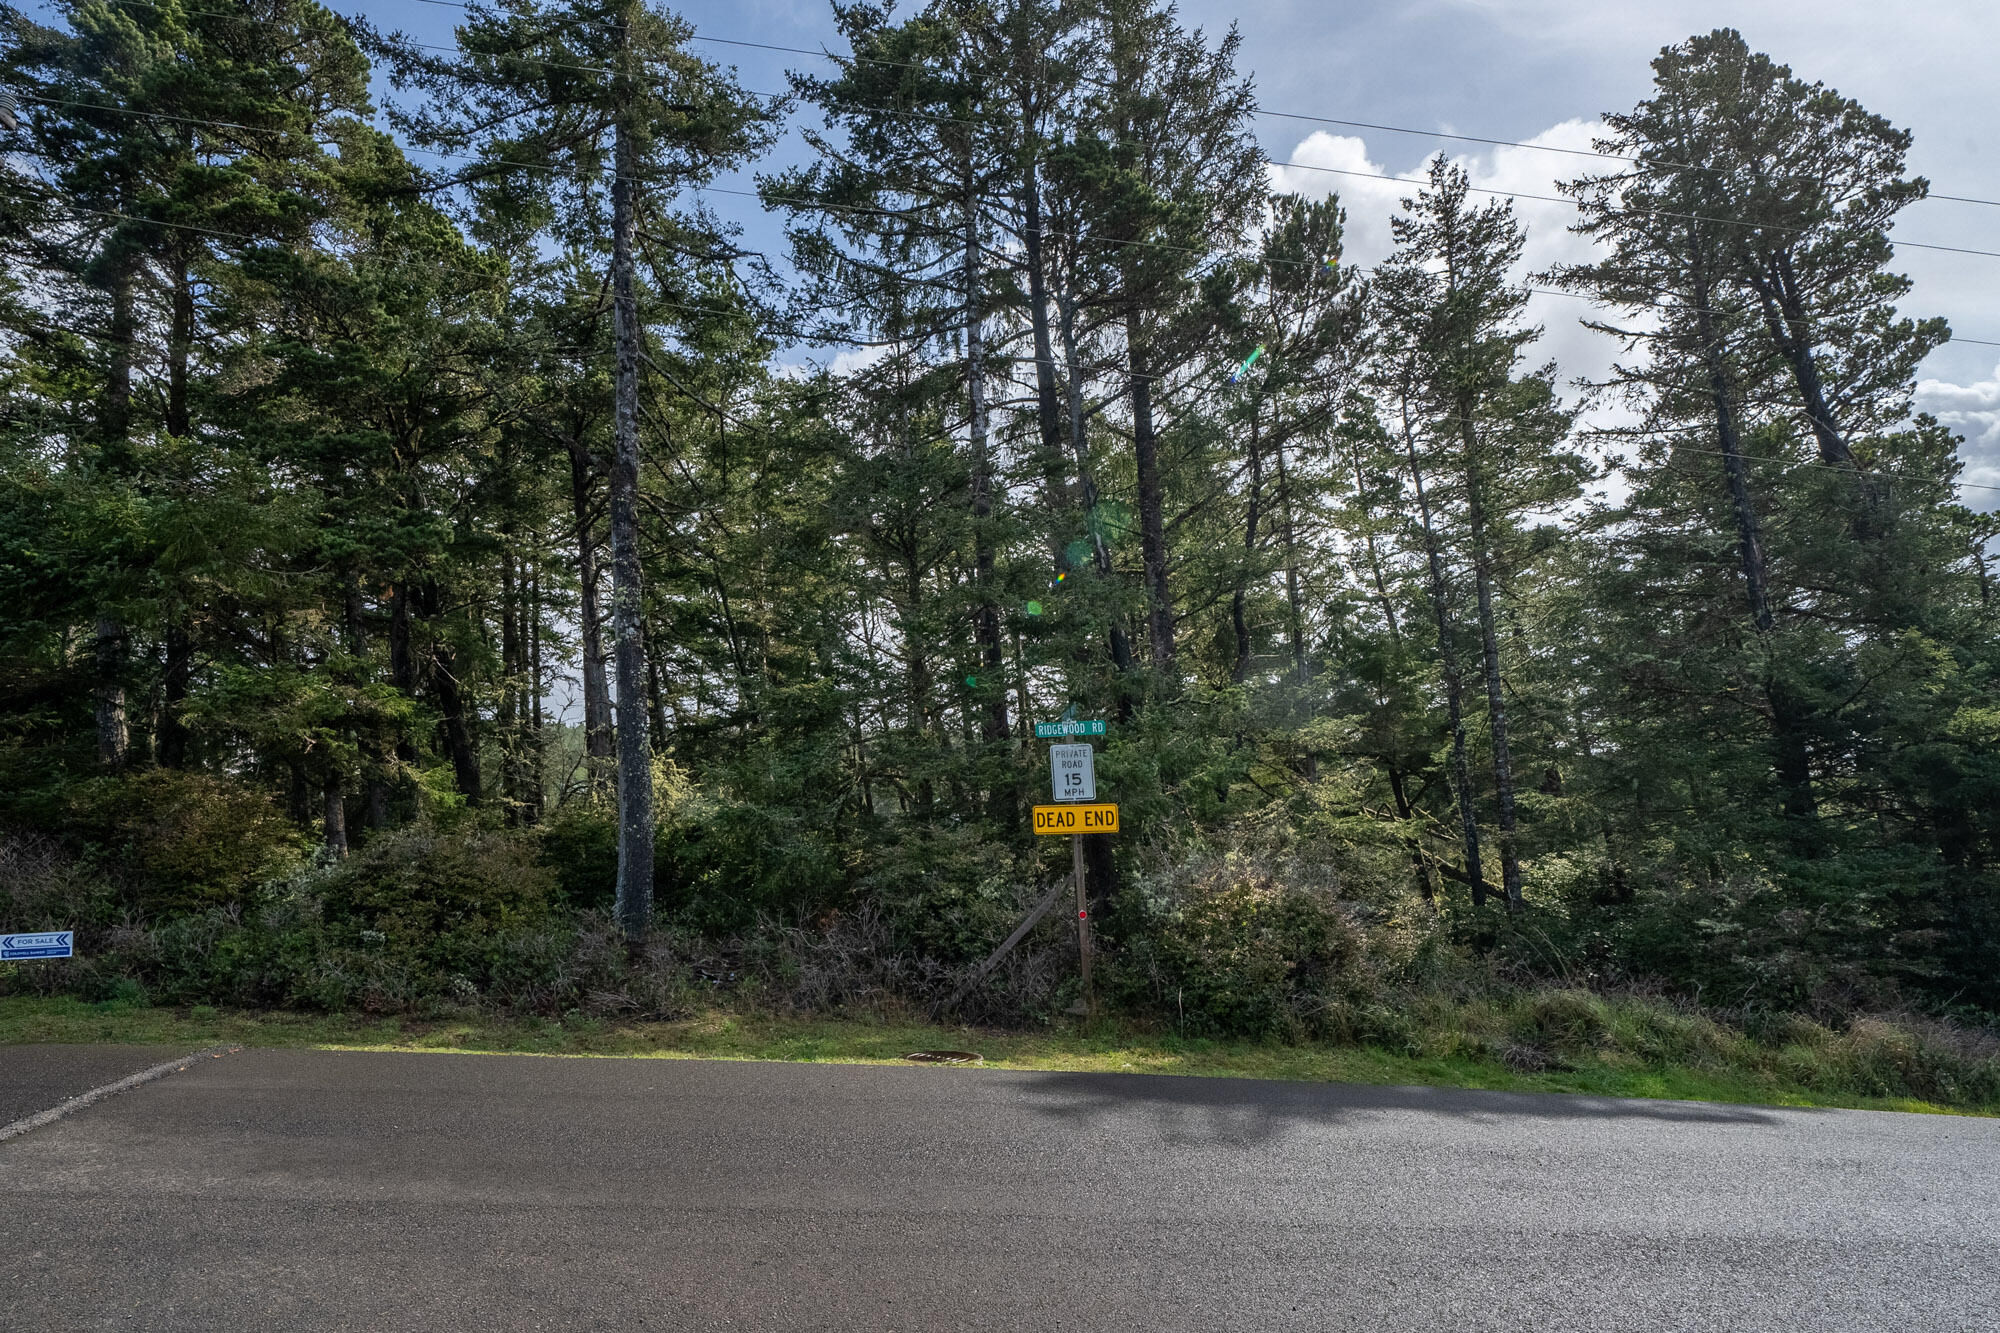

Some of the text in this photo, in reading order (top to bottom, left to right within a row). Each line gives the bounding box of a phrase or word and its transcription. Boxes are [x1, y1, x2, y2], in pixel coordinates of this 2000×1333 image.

[1038, 722, 1103, 735] RIDGEWOOD RD
[1056, 750, 1087, 758] PRIVATE
[1062, 760, 1082, 768] ROAD
[1064, 773, 1082, 786] 15
[1064, 788, 1084, 796] MPH
[1037, 811, 1114, 827] DEAD END
